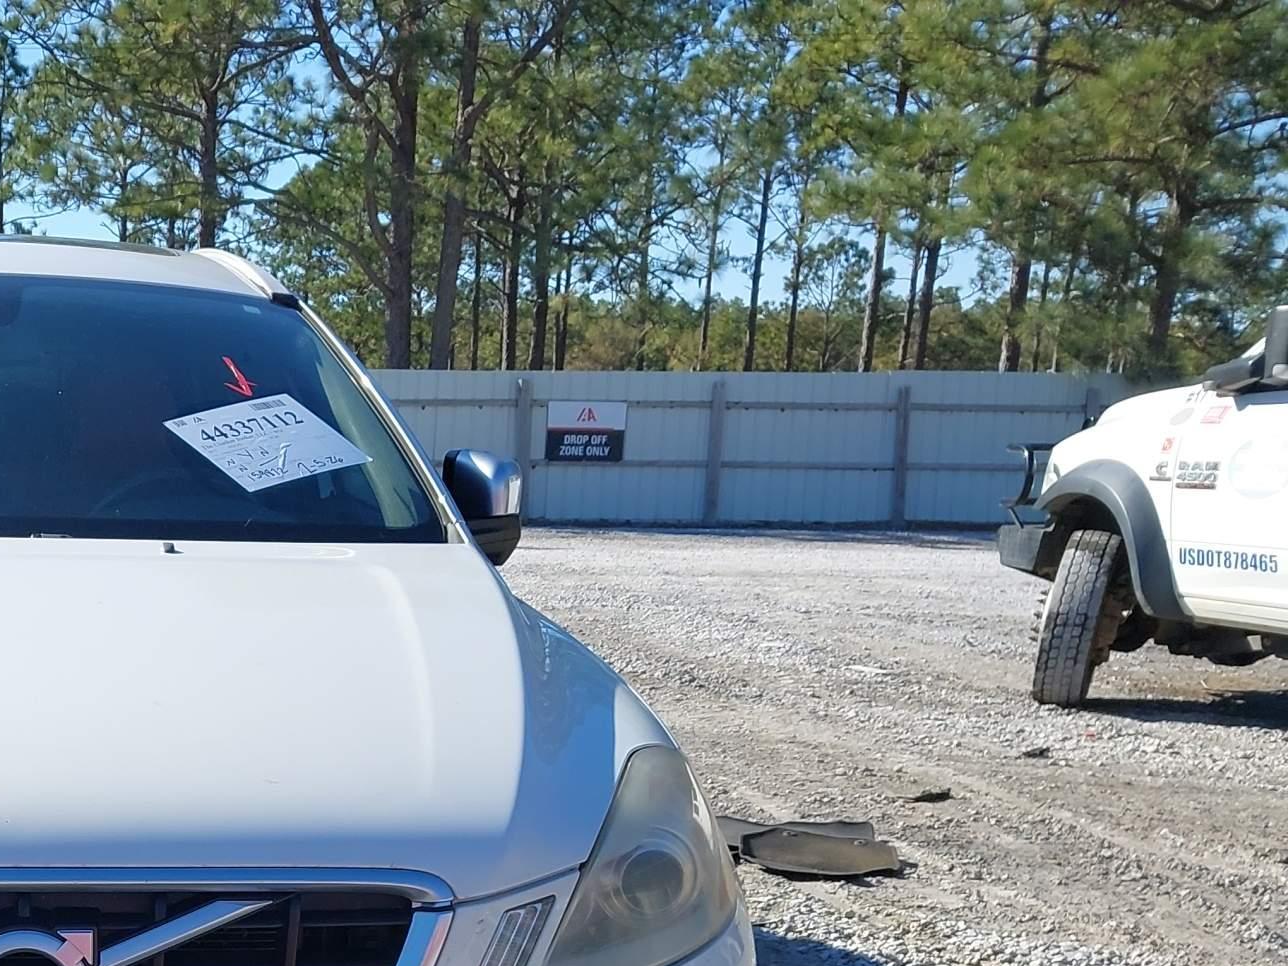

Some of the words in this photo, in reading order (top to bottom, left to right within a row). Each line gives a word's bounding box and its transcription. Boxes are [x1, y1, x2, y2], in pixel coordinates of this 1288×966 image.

[200, 411, 304, 442] 44337112
[563, 434, 590, 445] DROP
[591, 434, 608, 445] OFF
[559, 446, 585, 456] ZONE
[586, 446, 611, 456] ONLY
[1178, 460, 1221, 471] RAM
[1175, 471, 1218, 483] 4500
[1179, 547, 1279, 573] USDOT878465
